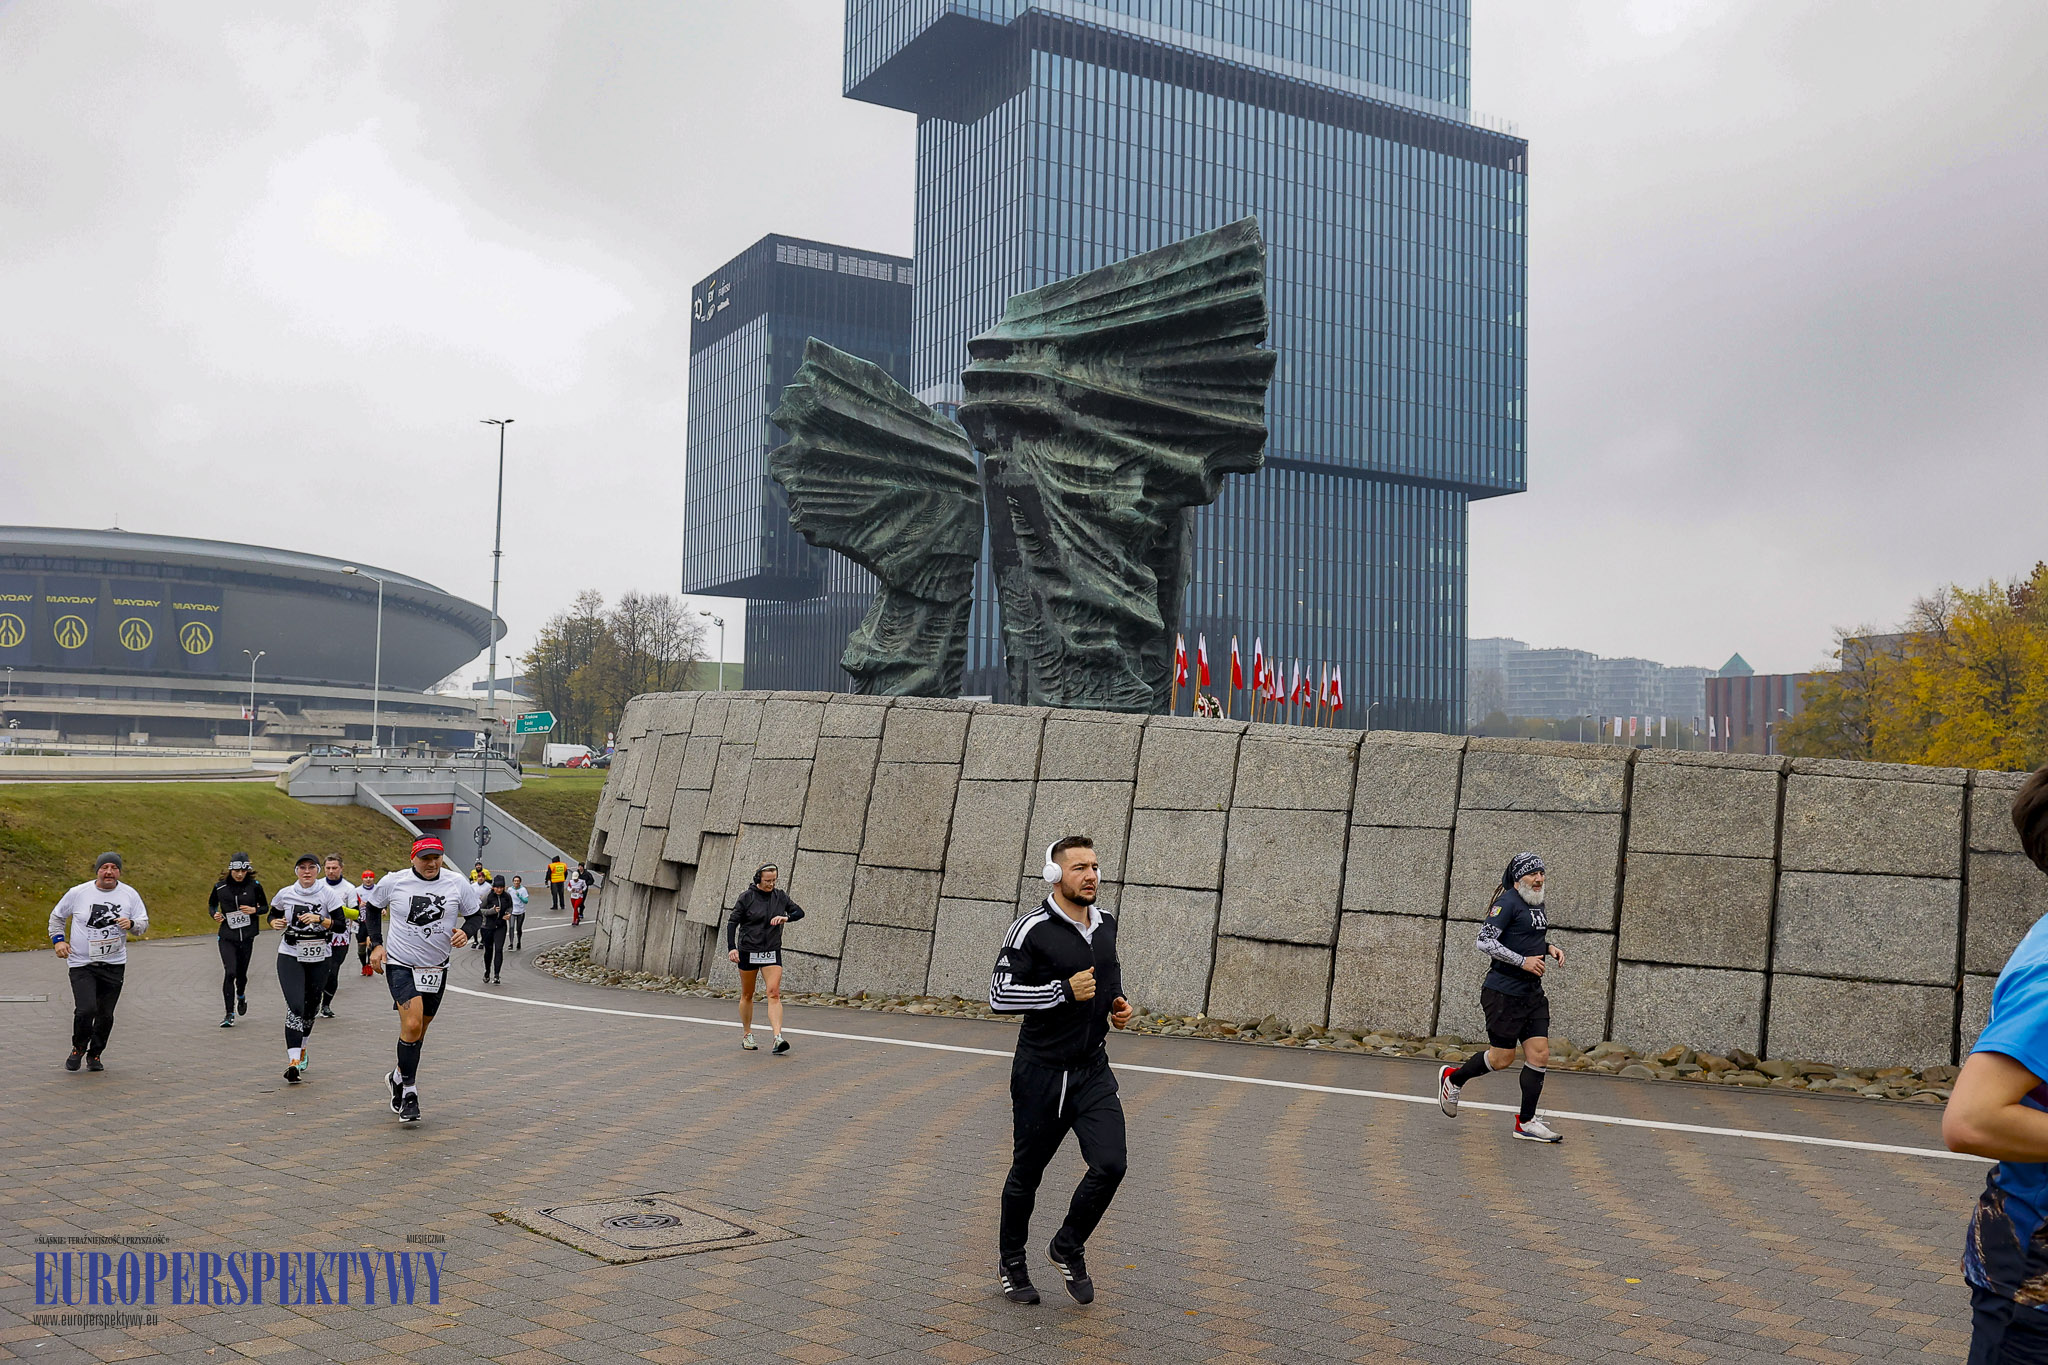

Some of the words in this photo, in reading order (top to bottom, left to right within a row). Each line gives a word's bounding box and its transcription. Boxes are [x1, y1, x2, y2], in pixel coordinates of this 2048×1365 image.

[0, 594, 33, 602] YDAY
[46, 595, 97, 604] MAYDAY
[113, 598, 161, 608] MAYDAY
[172, 602, 220, 612] MAYDAY
[231, 916, 246, 924] 366
[423, 927, 432, 939] 9
[99, 945, 112, 954] 17
[302, 946, 322, 956] 359
[420, 974, 439, 986] 627
